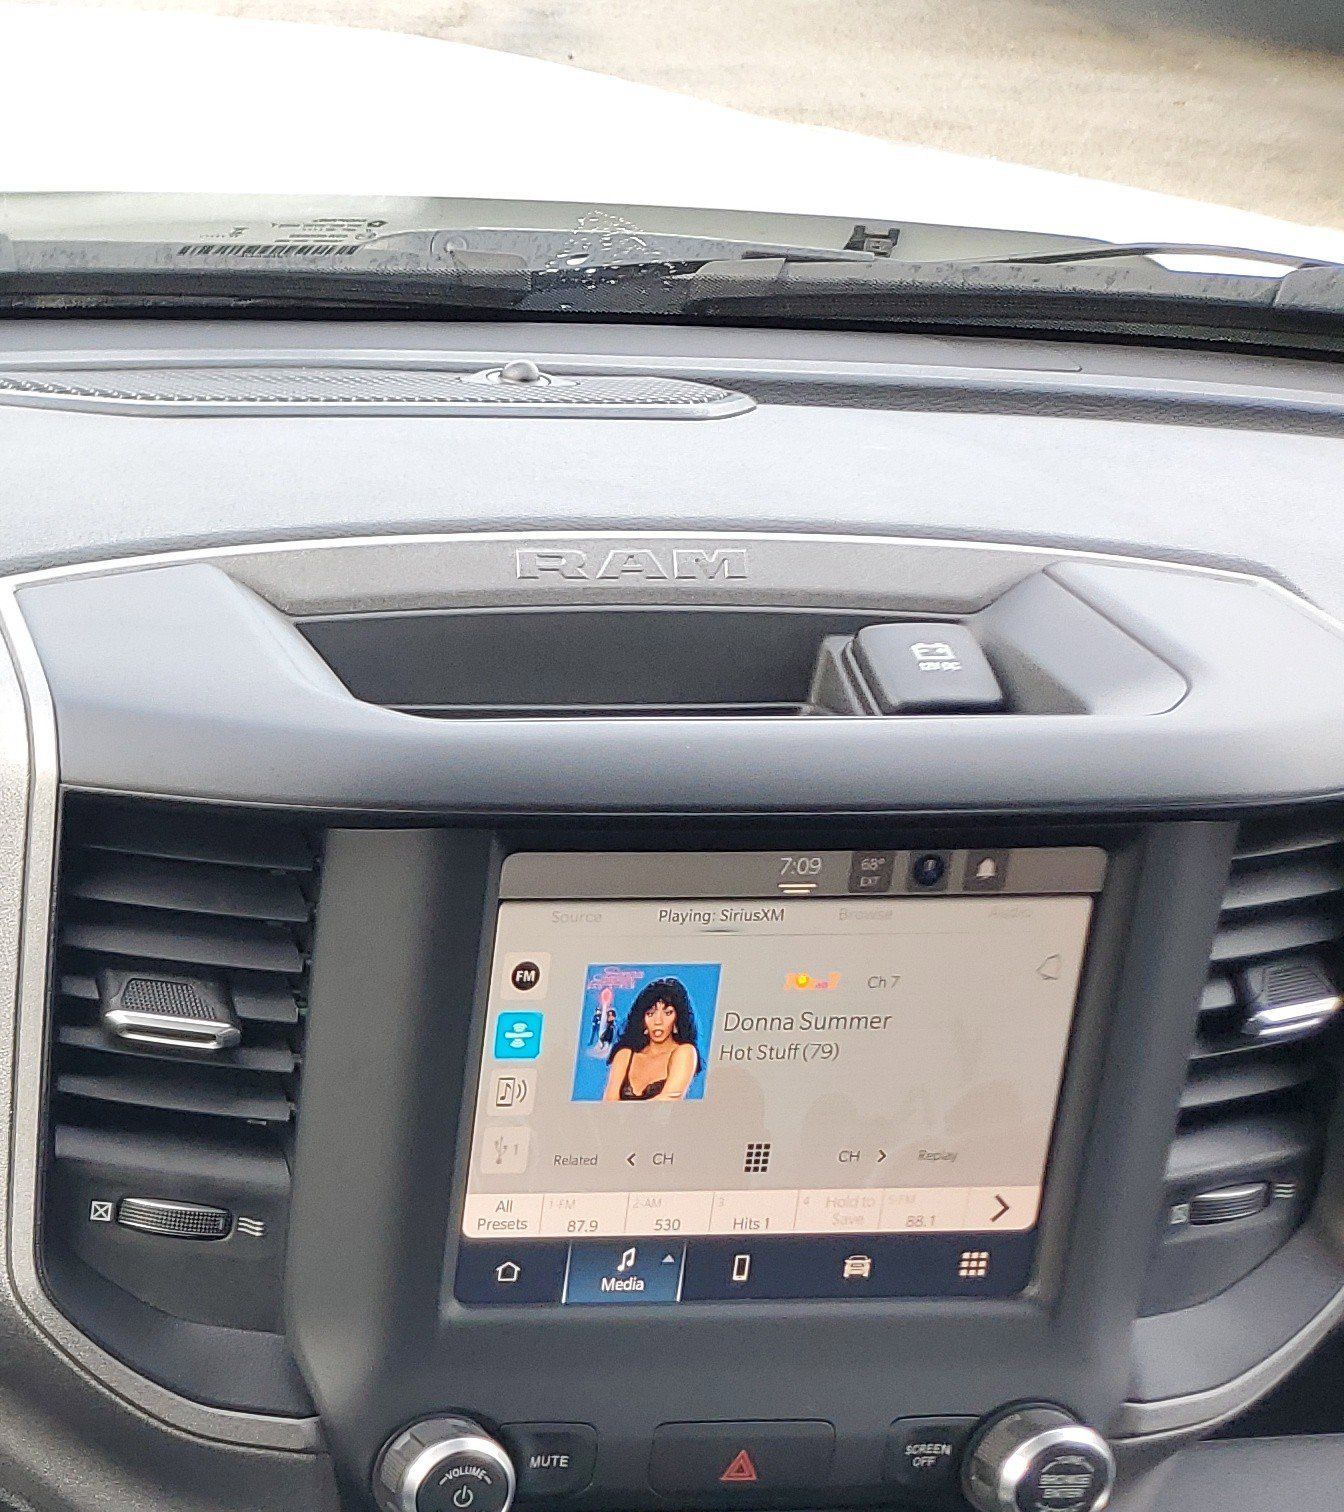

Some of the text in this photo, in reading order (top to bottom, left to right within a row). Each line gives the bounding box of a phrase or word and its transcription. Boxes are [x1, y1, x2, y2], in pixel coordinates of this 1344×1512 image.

[515, 548, 748, 581] RAM
[779, 857, 823, 876] 7:09
[658, 908, 786, 925] Playing: SiriusXM
[515, 970, 536, 982] FM
[867, 975, 902, 989] Ch 7
[723, 1011, 892, 1031] Donna Summer
[719, 1042, 841, 1063] Hot Stuff (79)
[553, 1153, 599, 1167] Related
[651, 1152, 675, 1166] CH
[837, 1150, 861, 1163] CH
[494, 1199, 514, 1213] All
[477, 1217, 528, 1232] Presets
[566, 1219, 599, 1233] 87.9
[653, 1218, 681, 1232] 530
[732, 1217, 759, 1230] Hits
[600, 1276, 646, 1292] Media
[904, 1442, 952, 1457] SCREEN
[529, 1455, 570, 1469] MUTE
[911, 1455, 937, 1468] OFF
[445, 1466, 486, 1481] VOLUME
